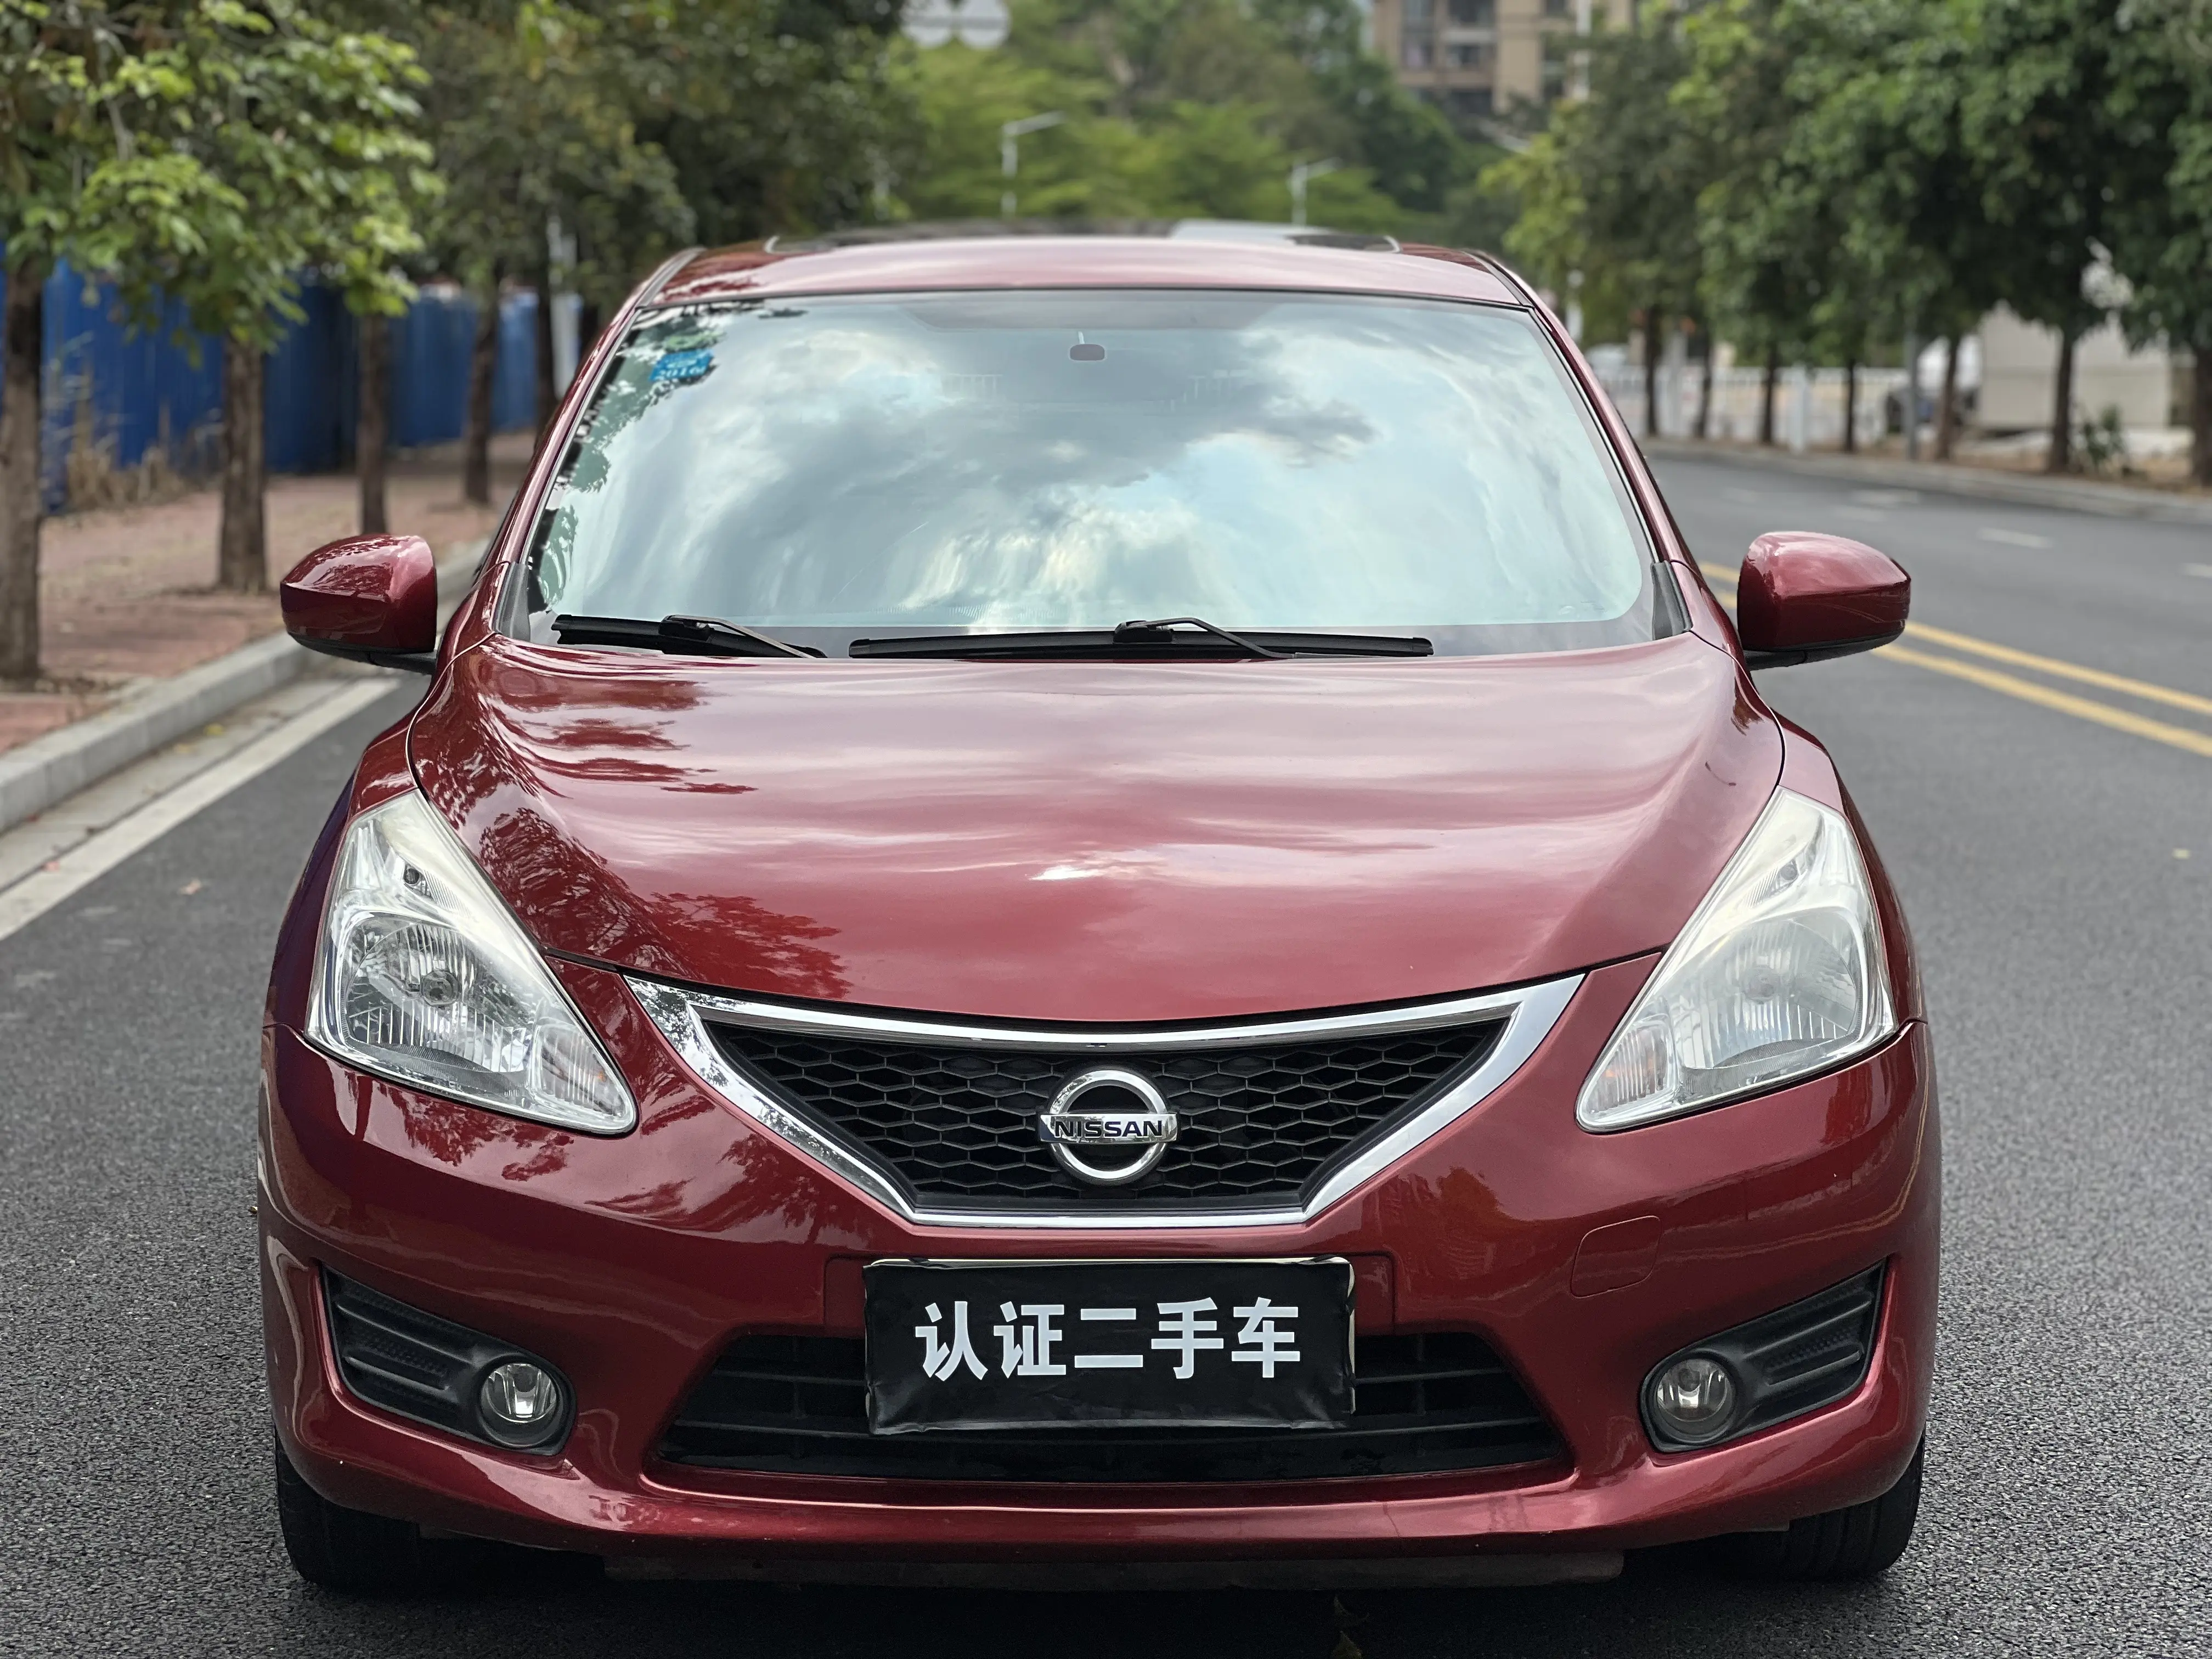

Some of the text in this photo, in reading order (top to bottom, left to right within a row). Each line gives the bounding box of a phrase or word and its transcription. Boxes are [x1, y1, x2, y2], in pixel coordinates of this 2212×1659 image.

[1054, 1120, 1163, 1138] NISSAN
[915, 1296, 1300, 1381] 认证二手车
